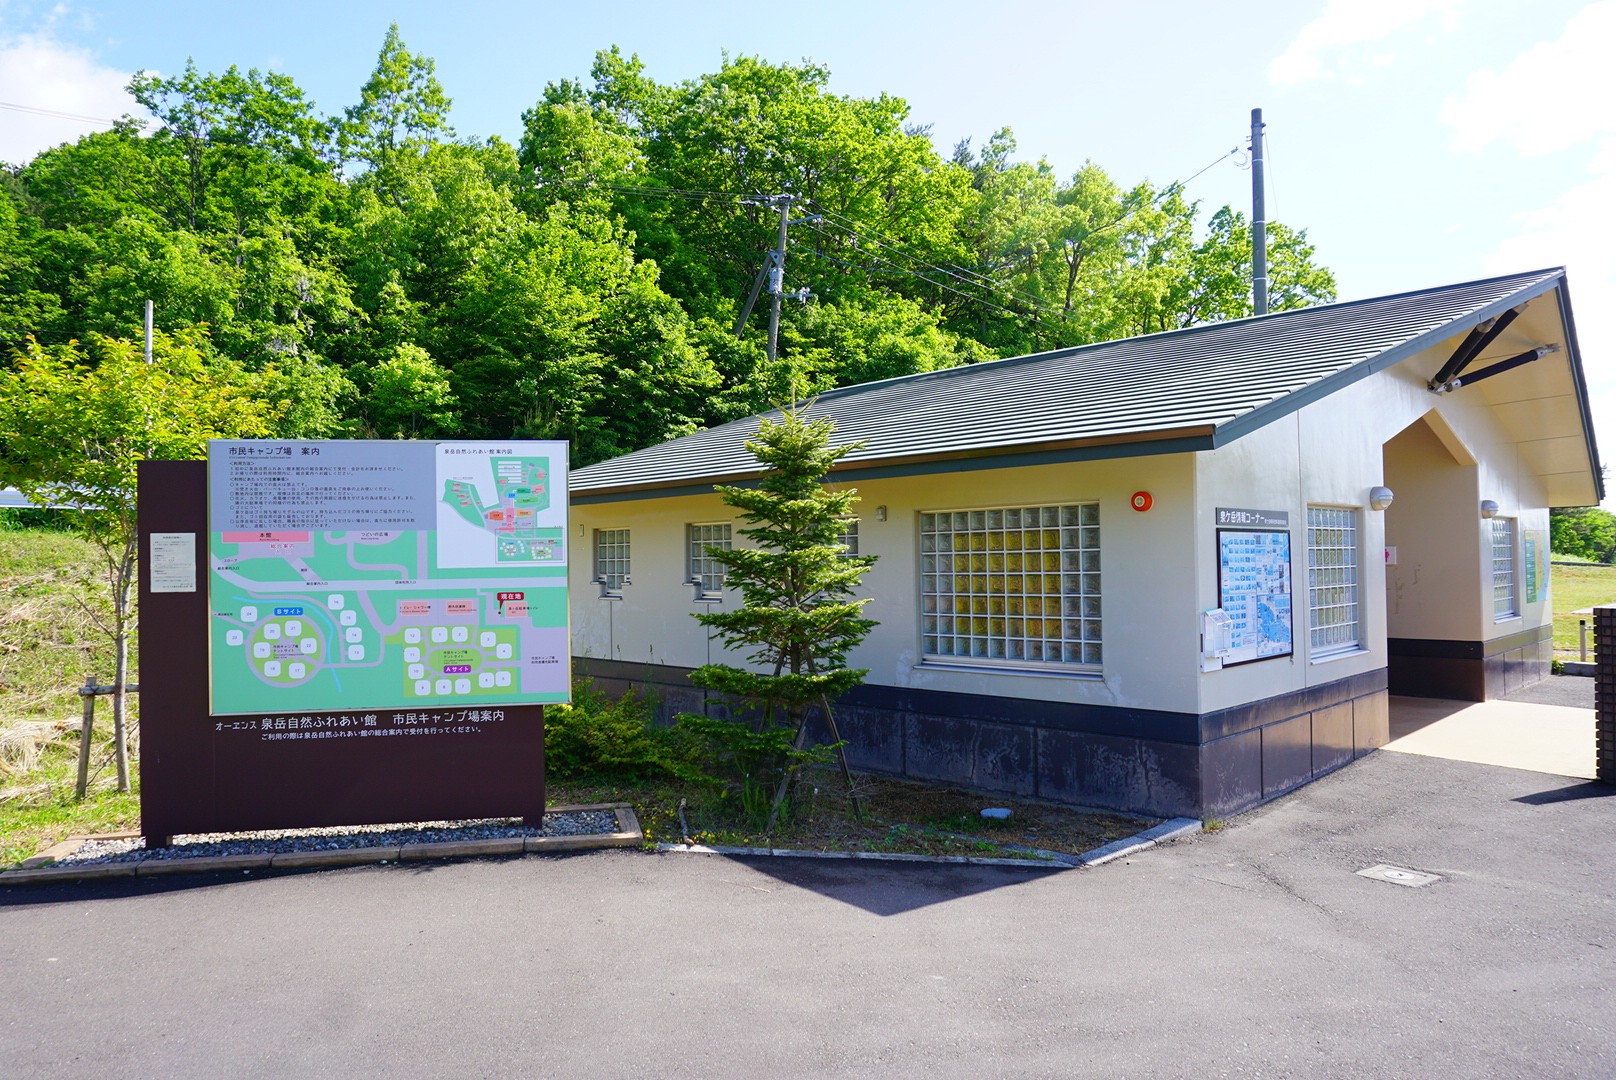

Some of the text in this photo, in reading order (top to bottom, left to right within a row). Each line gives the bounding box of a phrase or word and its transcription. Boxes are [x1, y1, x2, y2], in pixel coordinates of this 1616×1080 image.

[228, 446, 320, 456] 市民キャンプ場 案内
[261, 714, 377, 730] 泉岳自然ふれあい館
[393, 709, 504, 725] 市民キャンプ場案内
[262, 726, 481, 741] ご利用の際は泉岳自然ふれあい館の総合案内で受付を行ってください。
